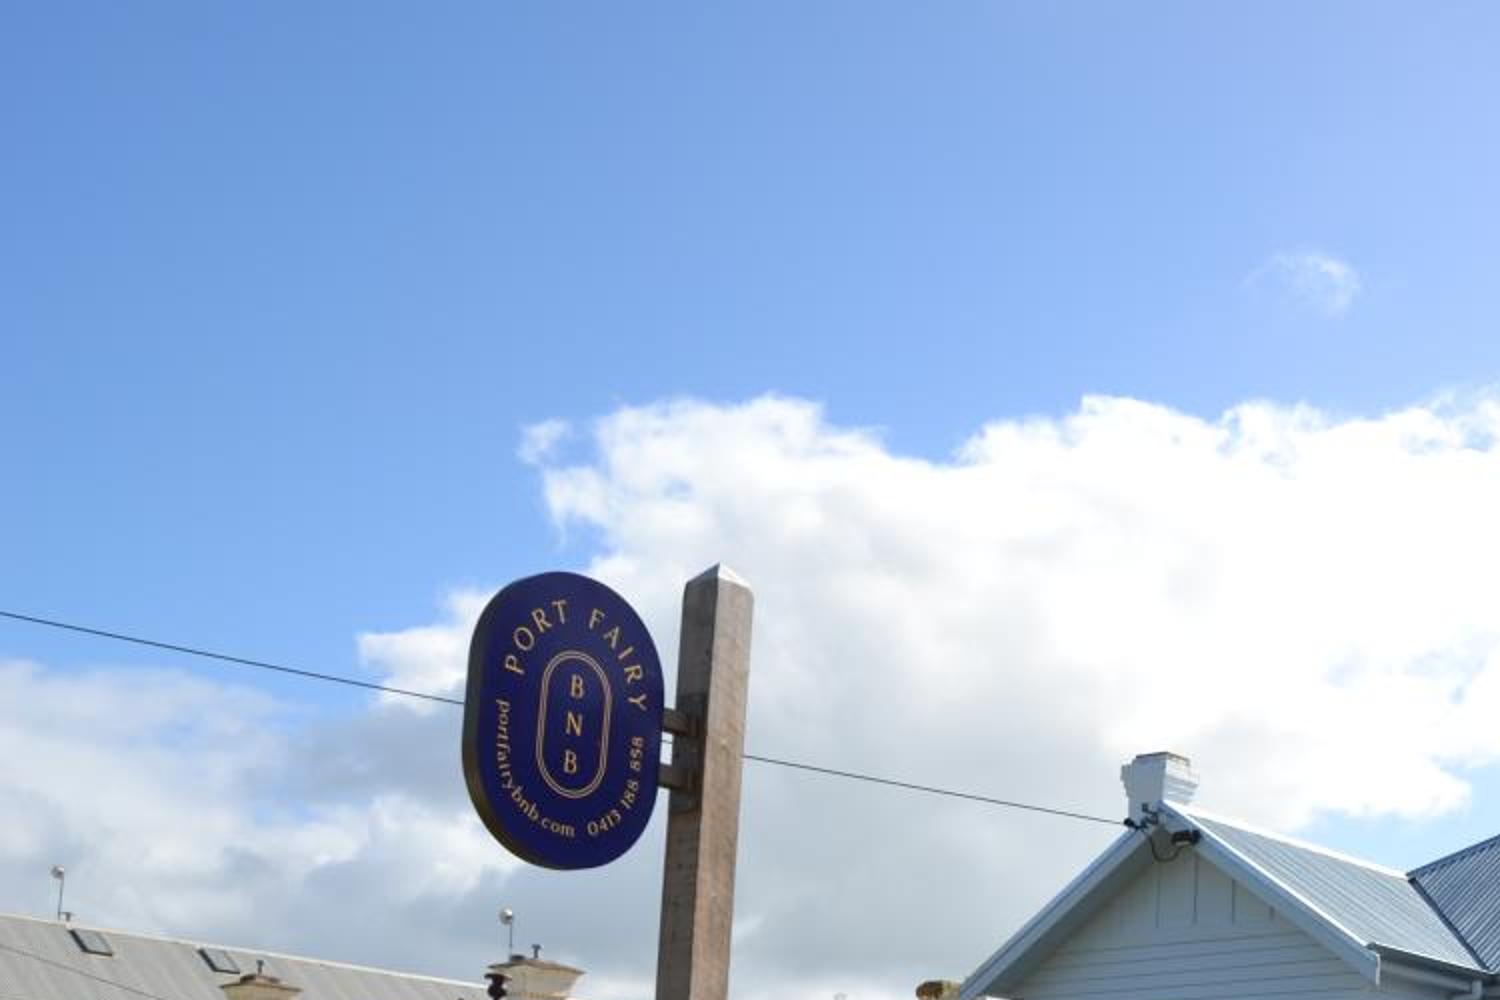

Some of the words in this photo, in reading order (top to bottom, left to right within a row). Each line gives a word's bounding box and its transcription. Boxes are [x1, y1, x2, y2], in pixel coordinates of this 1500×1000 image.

[504, 599, 568, 675] PORT
[589, 607, 648, 711] FAIRY
[495, 698, 576, 838] portfairybnb.com
